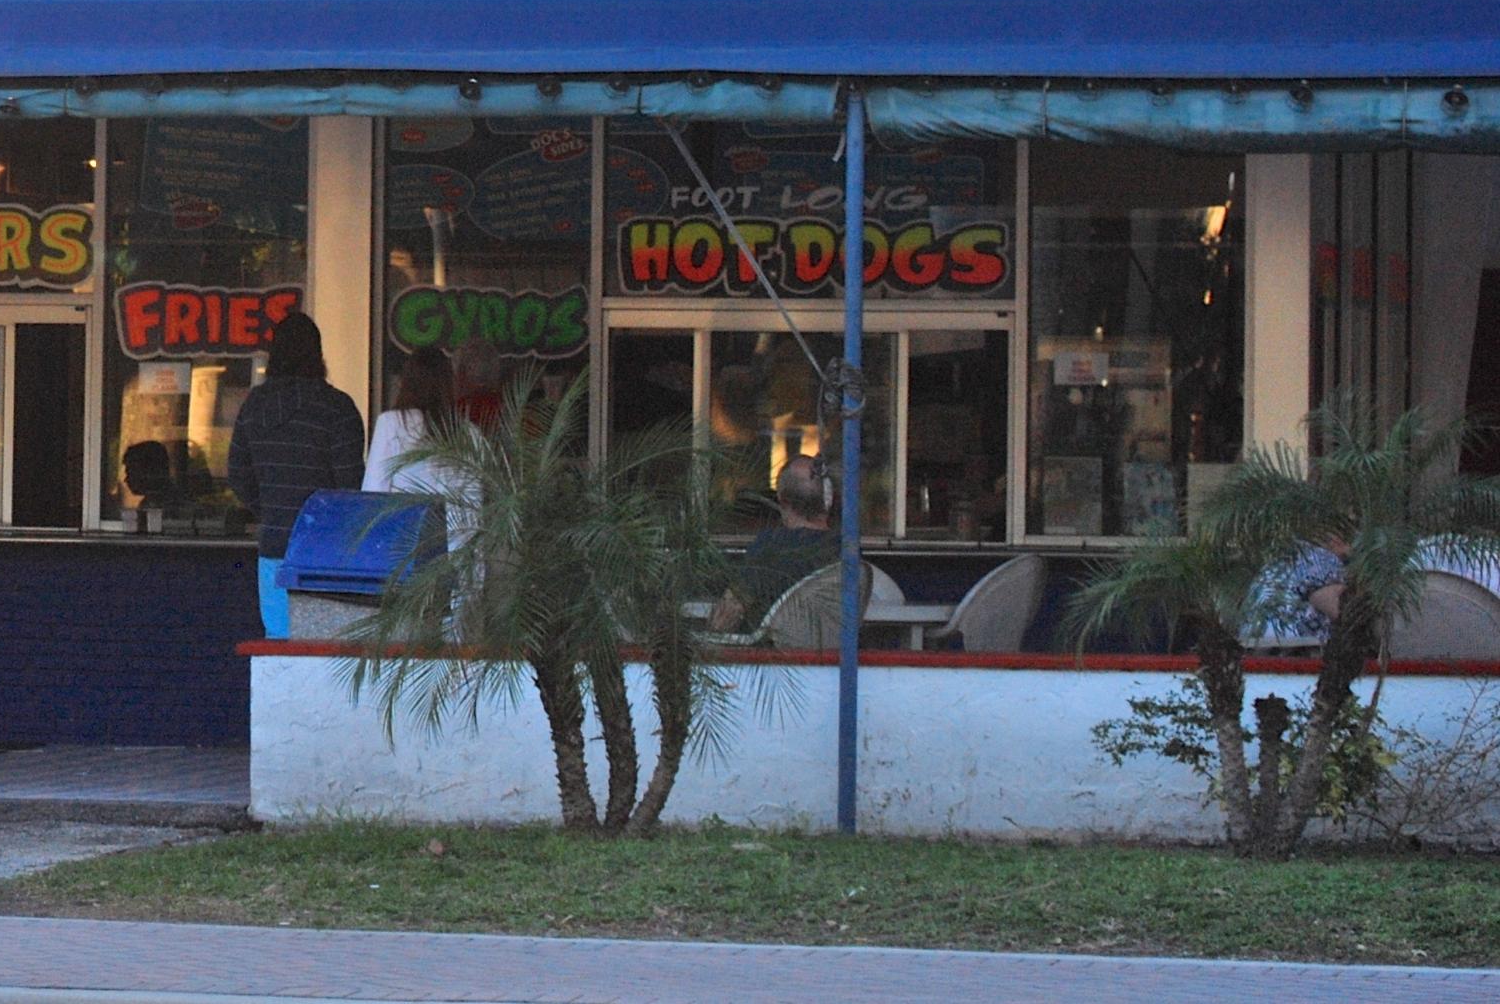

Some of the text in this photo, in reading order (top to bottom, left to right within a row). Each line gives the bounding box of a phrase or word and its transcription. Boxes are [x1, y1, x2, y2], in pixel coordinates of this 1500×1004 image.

[671, 186, 760, 209] FOOT
[630, 220, 1004, 286] HOT DOGS
[397, 291, 585, 347] GYROS
